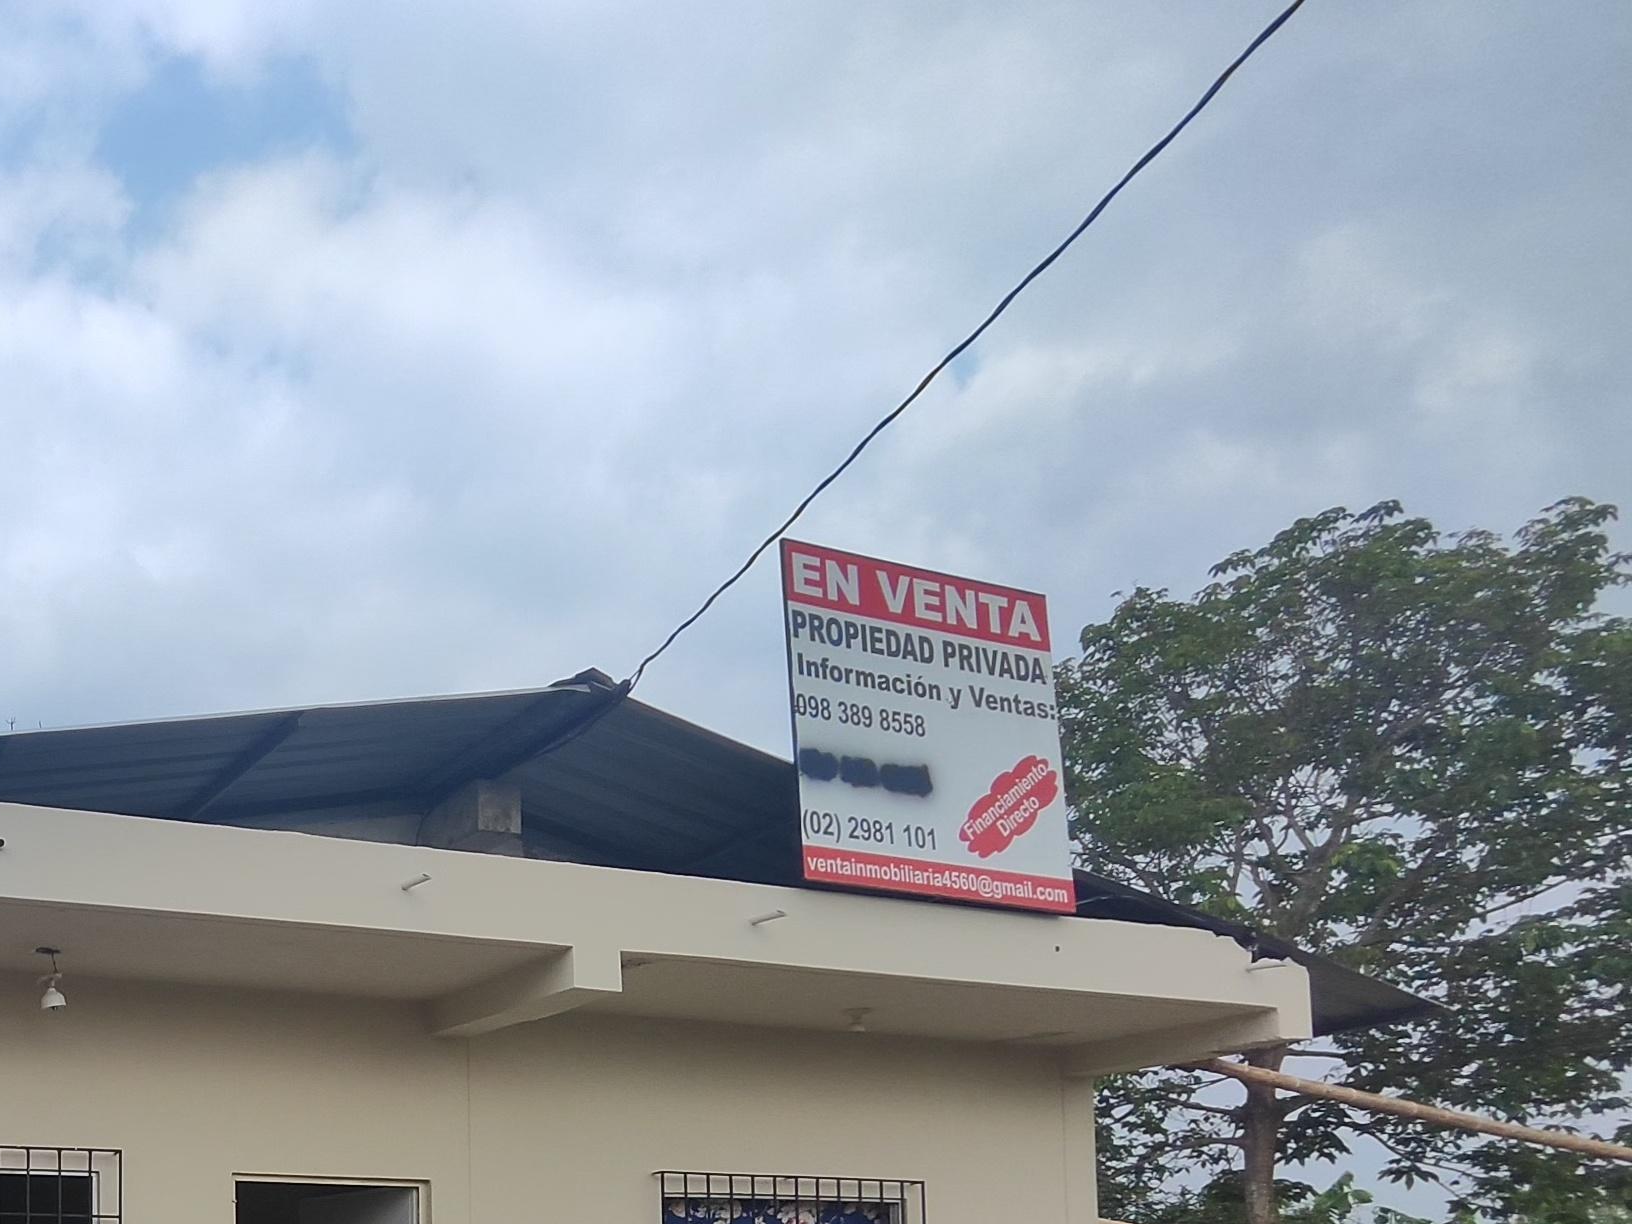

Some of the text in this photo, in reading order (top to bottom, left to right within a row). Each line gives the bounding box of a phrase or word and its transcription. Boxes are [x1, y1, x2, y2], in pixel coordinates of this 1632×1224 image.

[791, 552, 1042, 642] EN VENTA
[791, 609, 1047, 685] PROPIEDAD PRIVADA
[797, 652, 1056, 720] Información y Ventas:
[796, 693, 926, 737] 098 389 8558
[803, 809, 936, 850] (02) 2981 101
[964, 763, 1047, 840] Financiamiento
[996, 796, 1039, 837] Directo
[807, 856, 1068, 903] ventainmobiliaria4560@gmail.com
